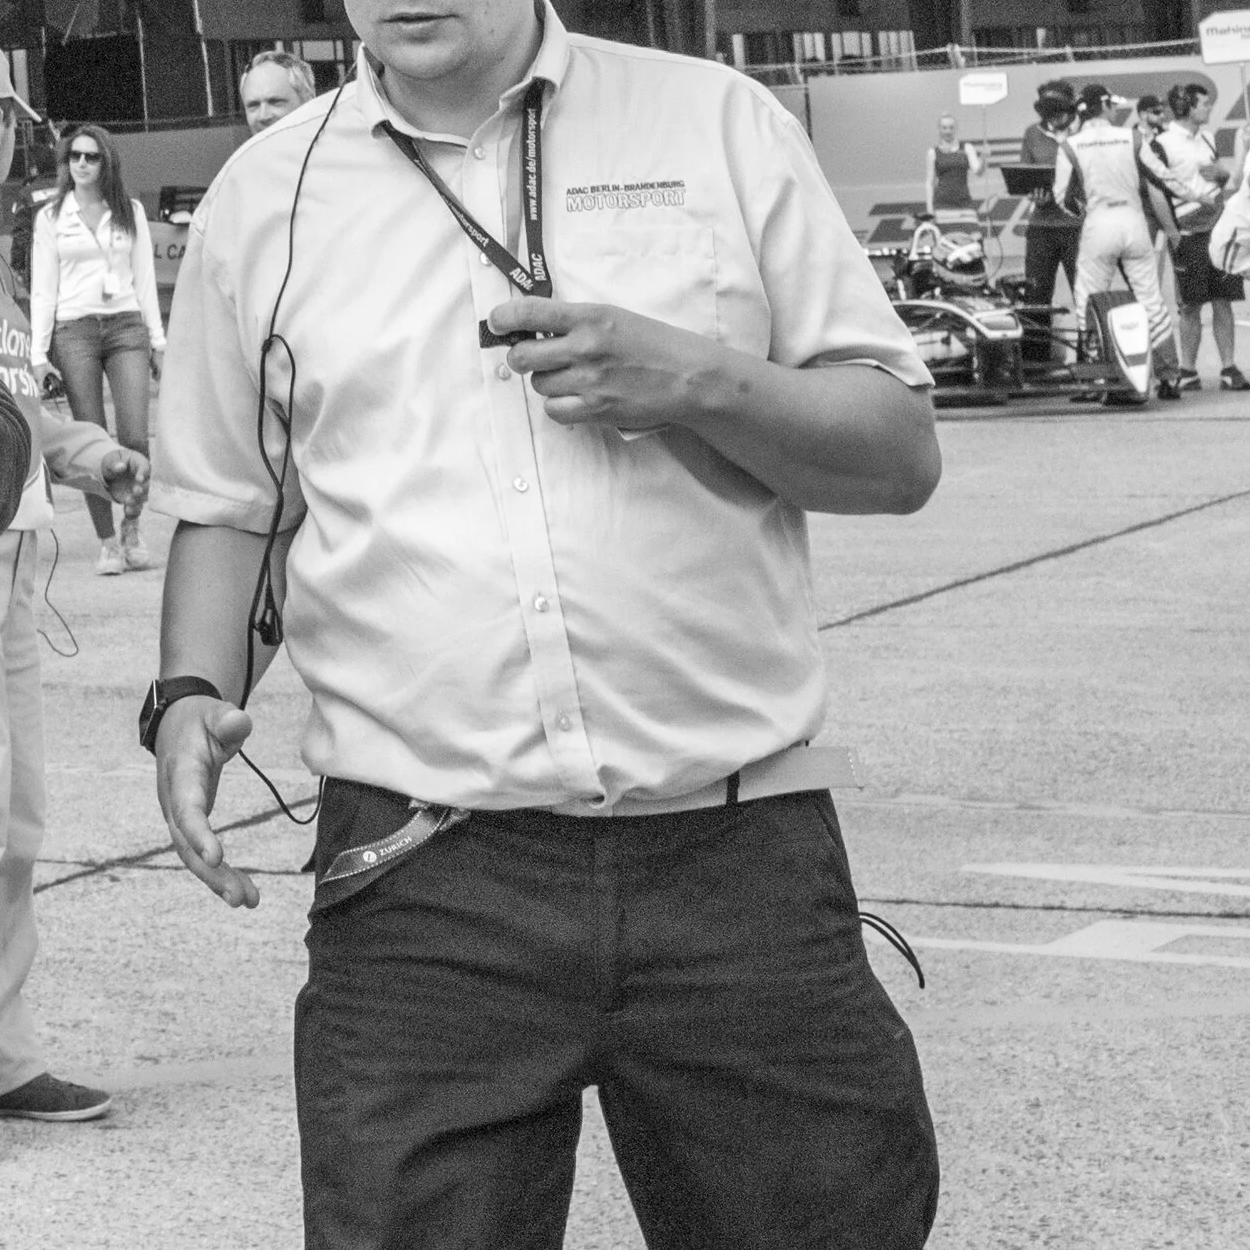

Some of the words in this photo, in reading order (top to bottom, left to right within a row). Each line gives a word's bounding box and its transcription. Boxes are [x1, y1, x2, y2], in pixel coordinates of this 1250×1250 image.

[566, 187, 589, 195] ADAC
[566, 189, 687, 213] MOTORSPORT
[531, 252, 548, 281] ADAC
[379, 836, 412, 856] ZURICH
